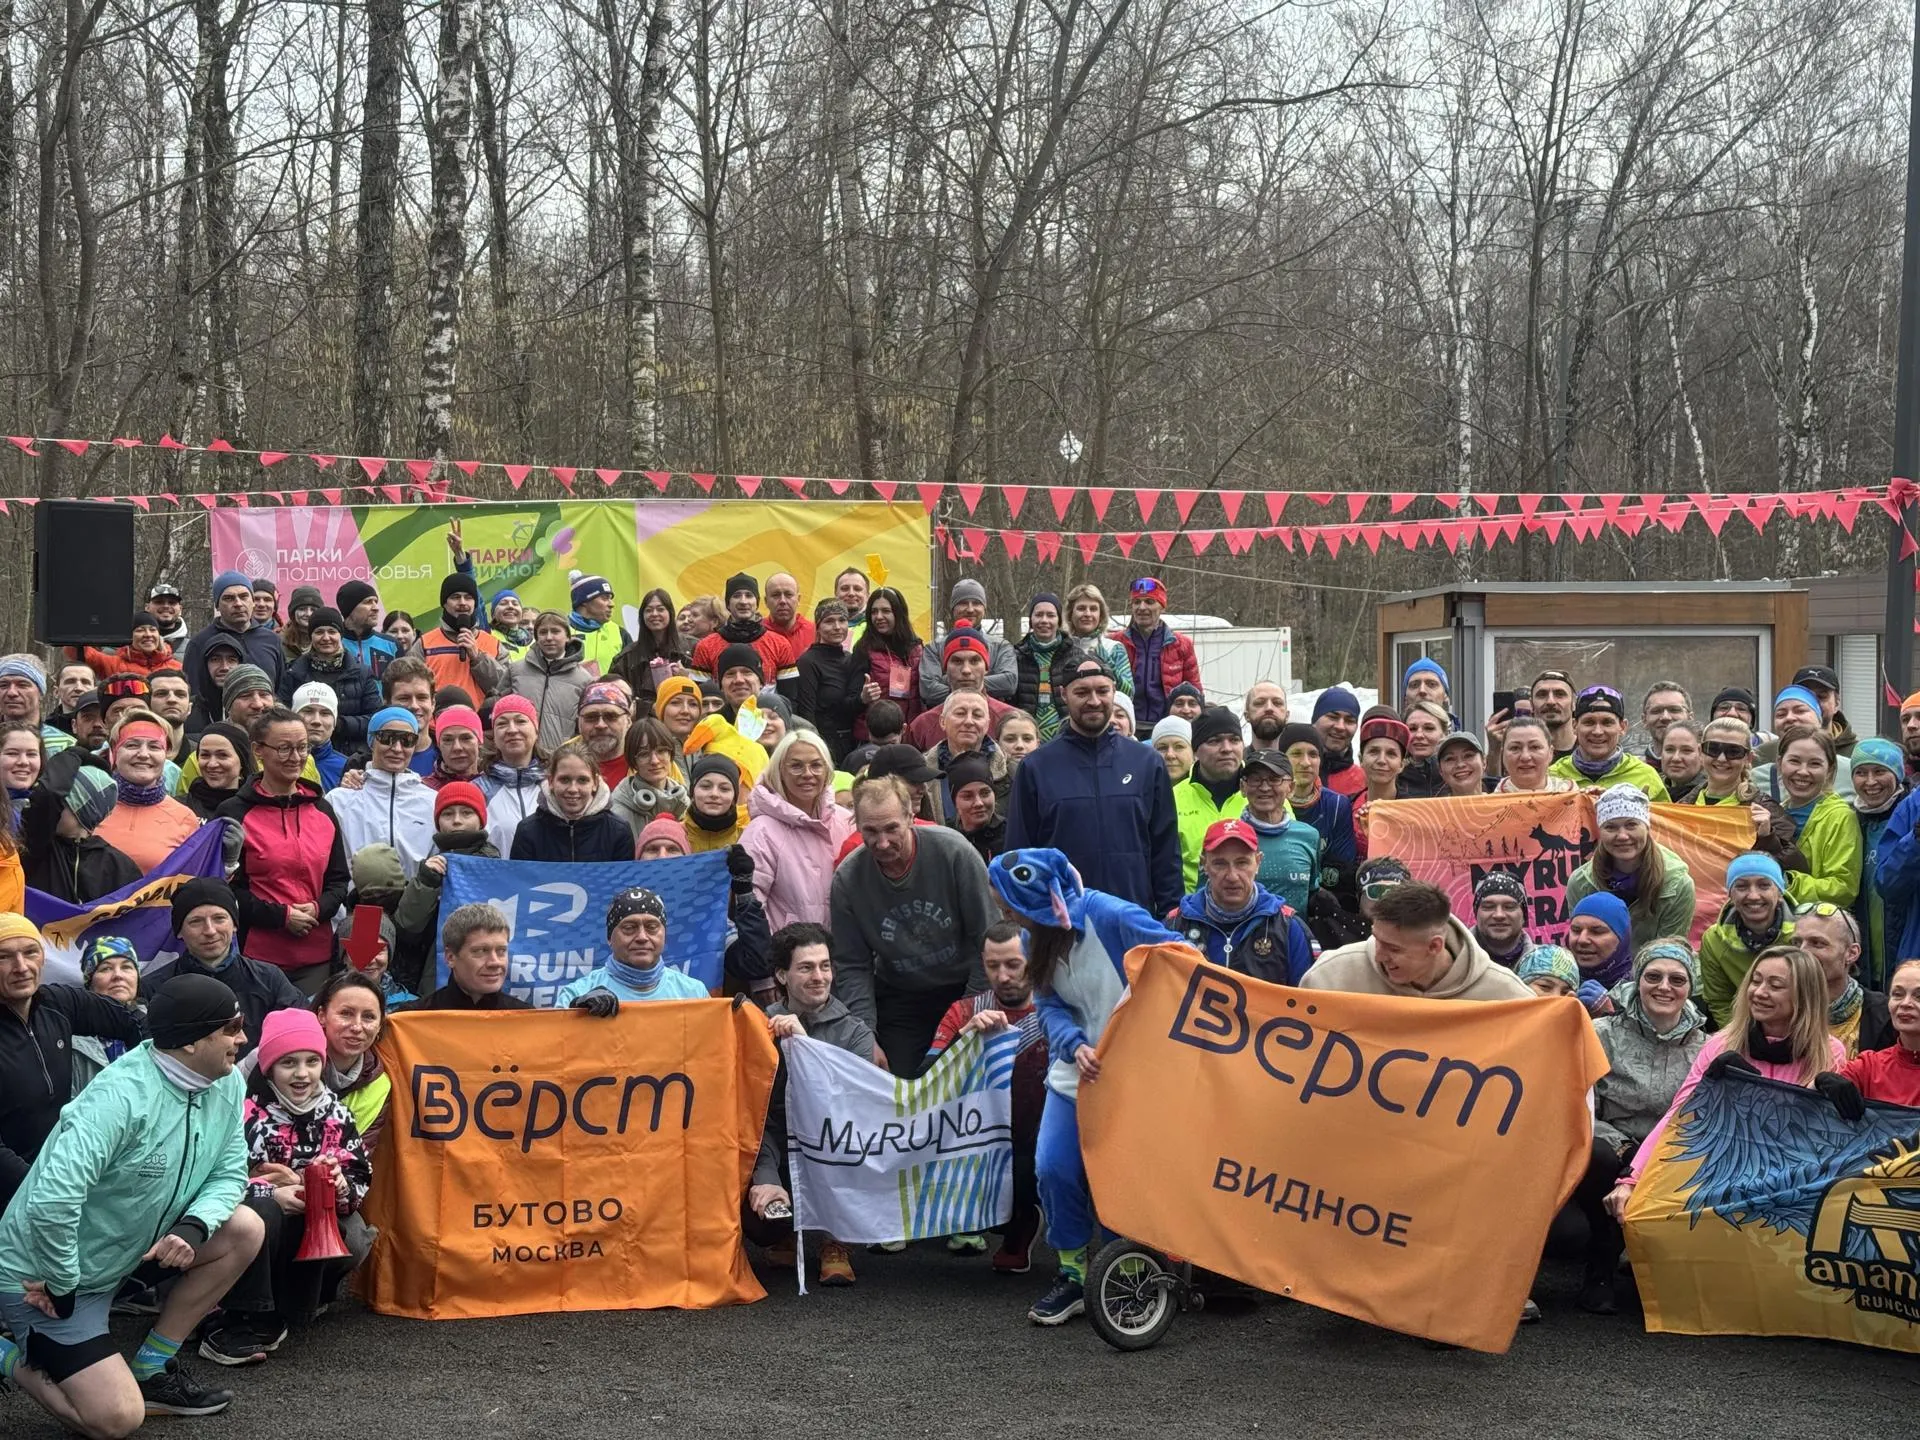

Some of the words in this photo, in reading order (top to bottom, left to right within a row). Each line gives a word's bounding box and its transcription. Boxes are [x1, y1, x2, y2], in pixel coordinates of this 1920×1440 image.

[277, 548, 343, 564] ПАРКИ
[469, 548, 534, 564] ПАРКИ
[277, 564, 433, 582] ПОДМОСКОВЬЯ
[510, 947, 595, 983] RUN
[473, 1197, 624, 1228] БУТОВО
[1212, 1157, 1414, 1248] ВИДНОЕ
[492, 1240, 605, 1264] МОСКВА
[1811, 1258, 1920, 1300] anan
